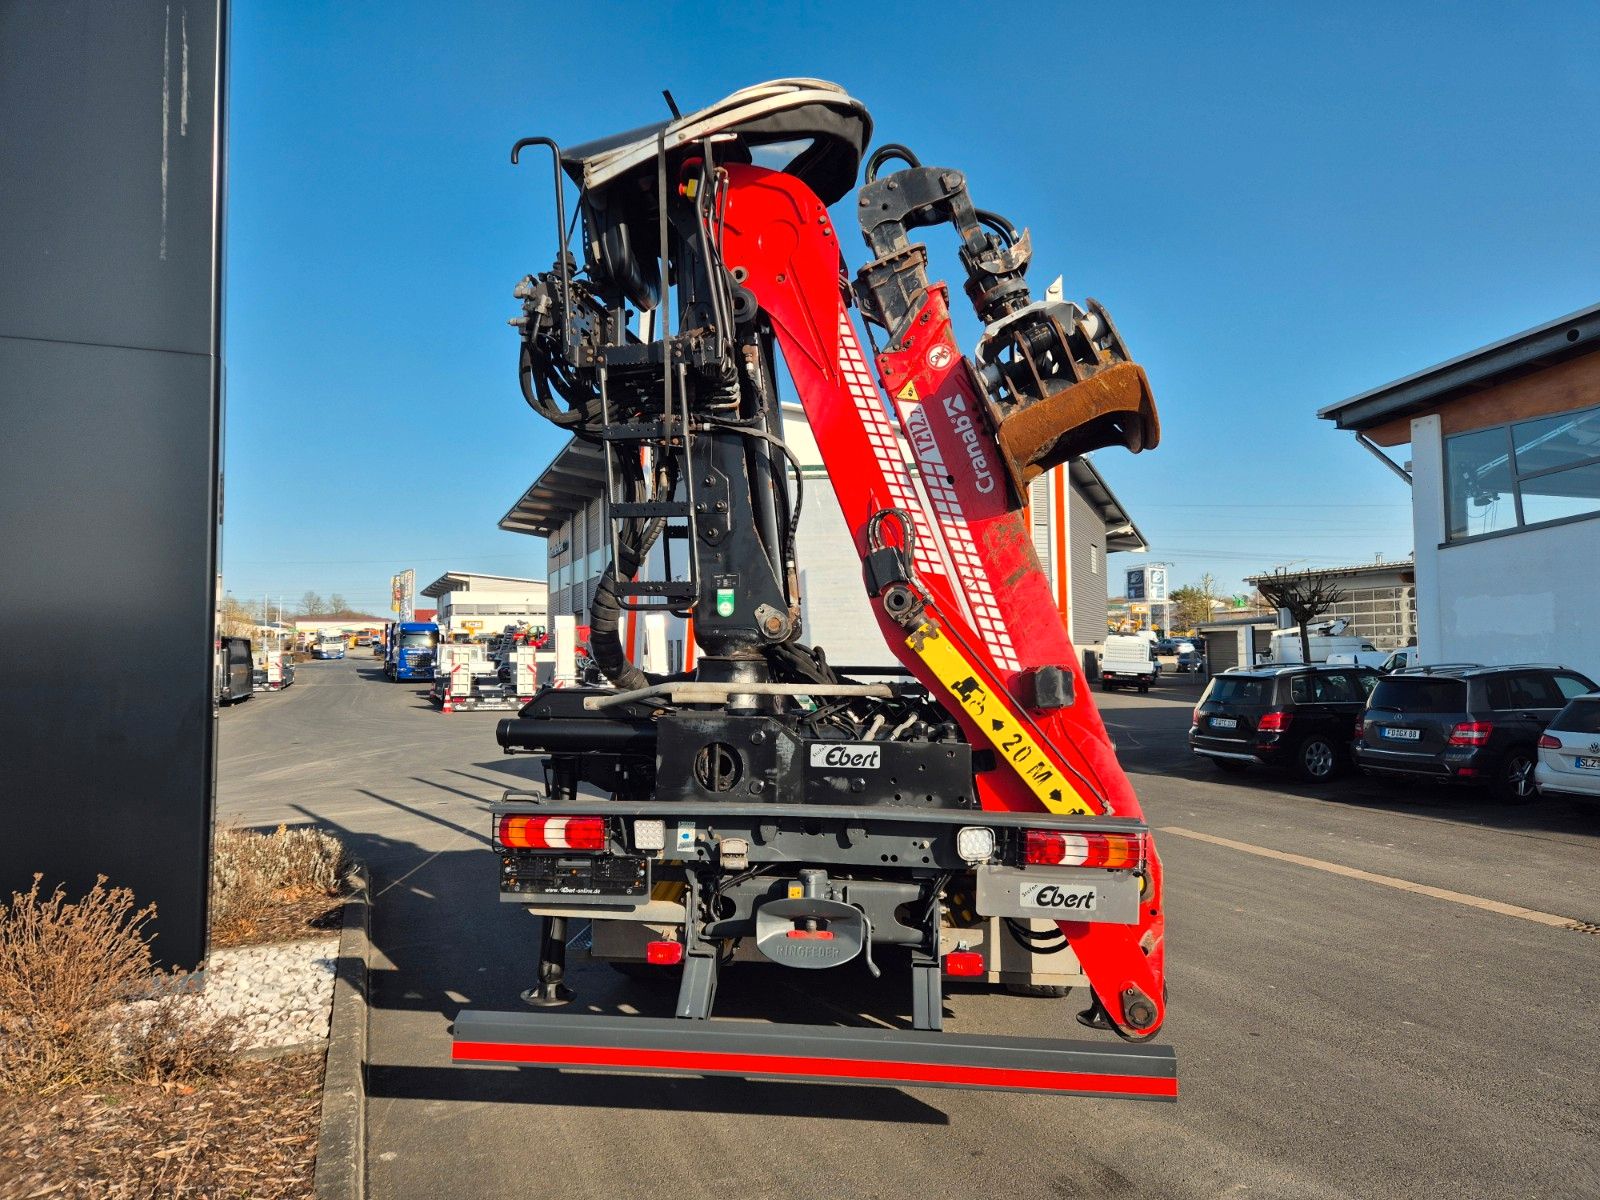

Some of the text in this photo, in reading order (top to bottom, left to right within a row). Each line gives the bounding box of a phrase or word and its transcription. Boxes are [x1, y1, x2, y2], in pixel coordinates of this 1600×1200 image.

[954, 416, 994, 493] Cranab
[825, 745, 879, 767] Ebert
[1002, 733, 1053, 786] 20 M
[1036, 885, 1095, 909] Ebert
[776, 943, 841, 959] RINGFEDER
